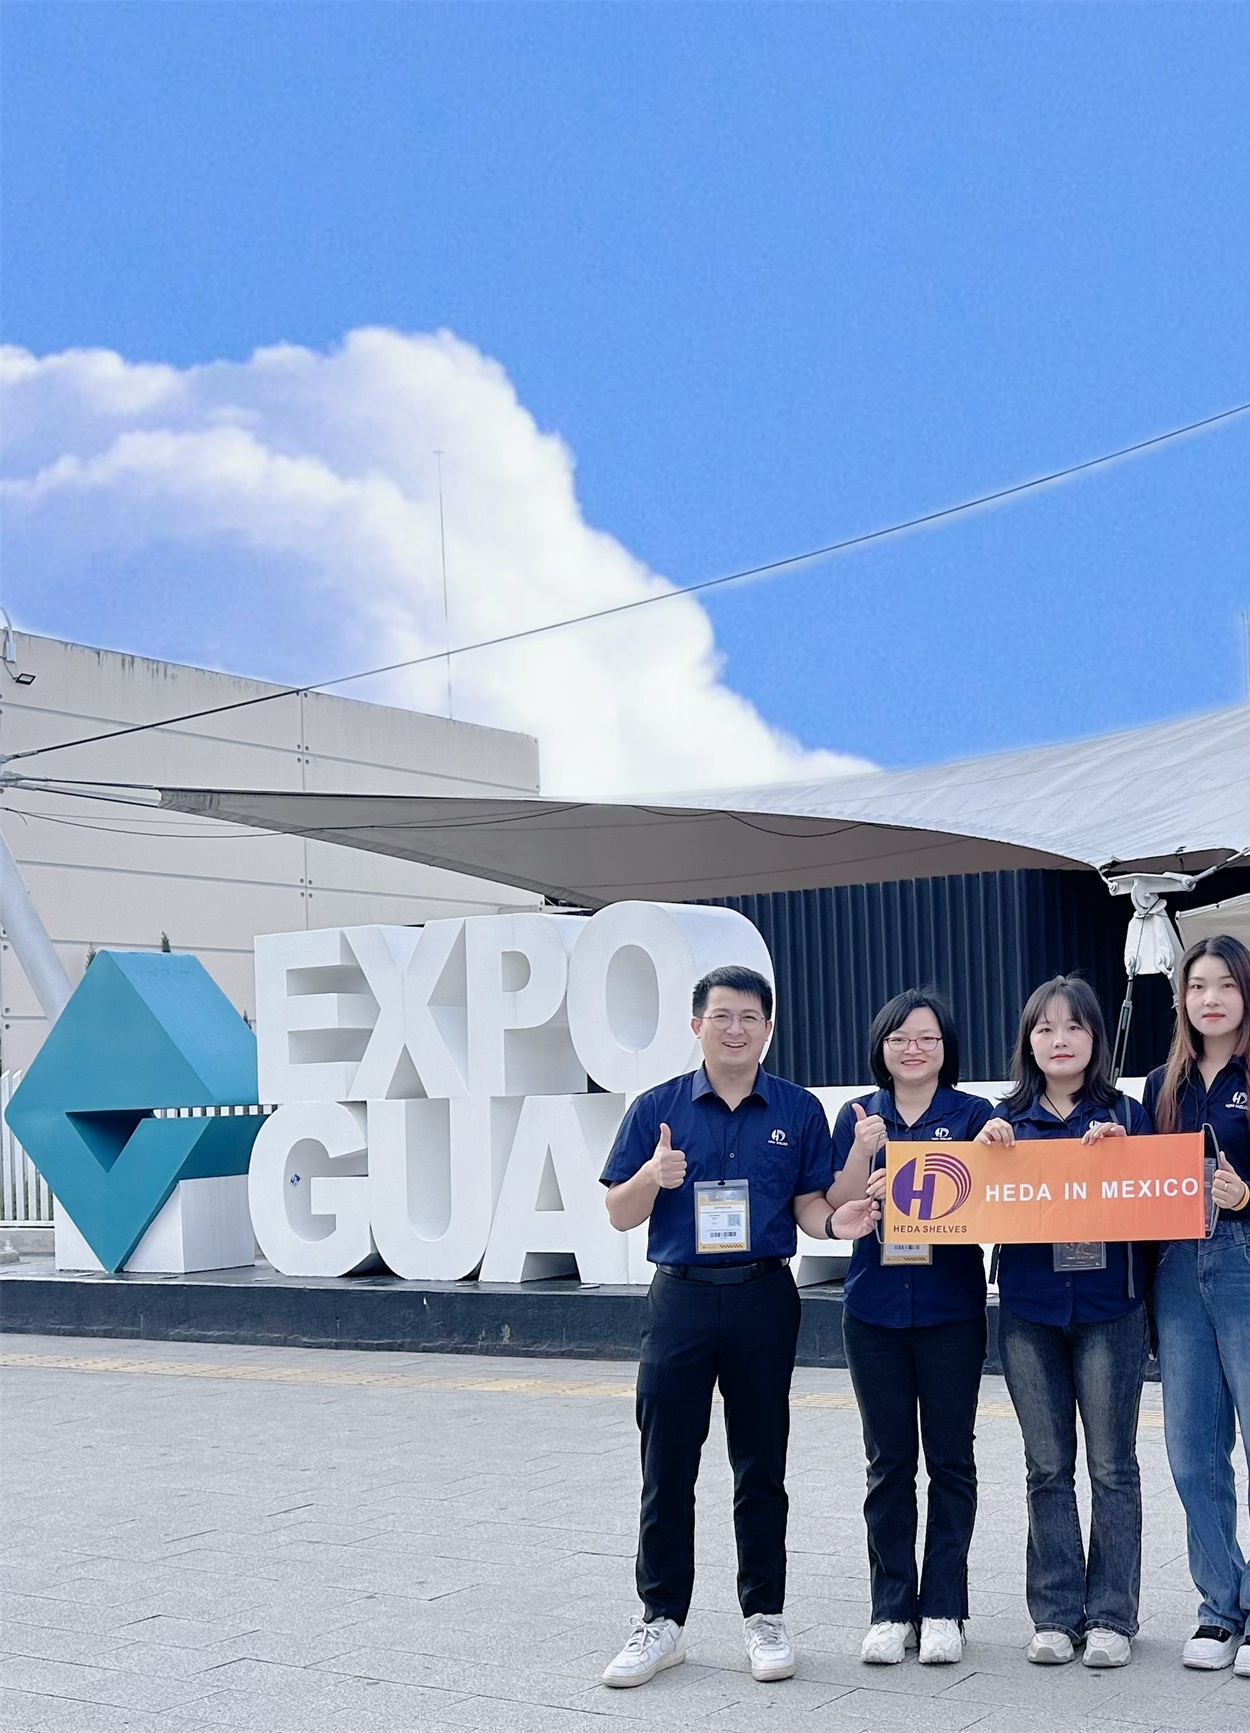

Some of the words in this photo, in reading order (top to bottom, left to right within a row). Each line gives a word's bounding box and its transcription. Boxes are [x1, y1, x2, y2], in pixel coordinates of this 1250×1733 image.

[254, 901, 775, 1103] EXPO
[985, 1183, 1052, 1202] HEDA
[1064, 1182, 1087, 1200] IN
[1101, 1177, 1199, 1199] MEXICO
[893, 1225, 921, 1233] HEDA
[922, 1225, 968, 1234] SHELVES
